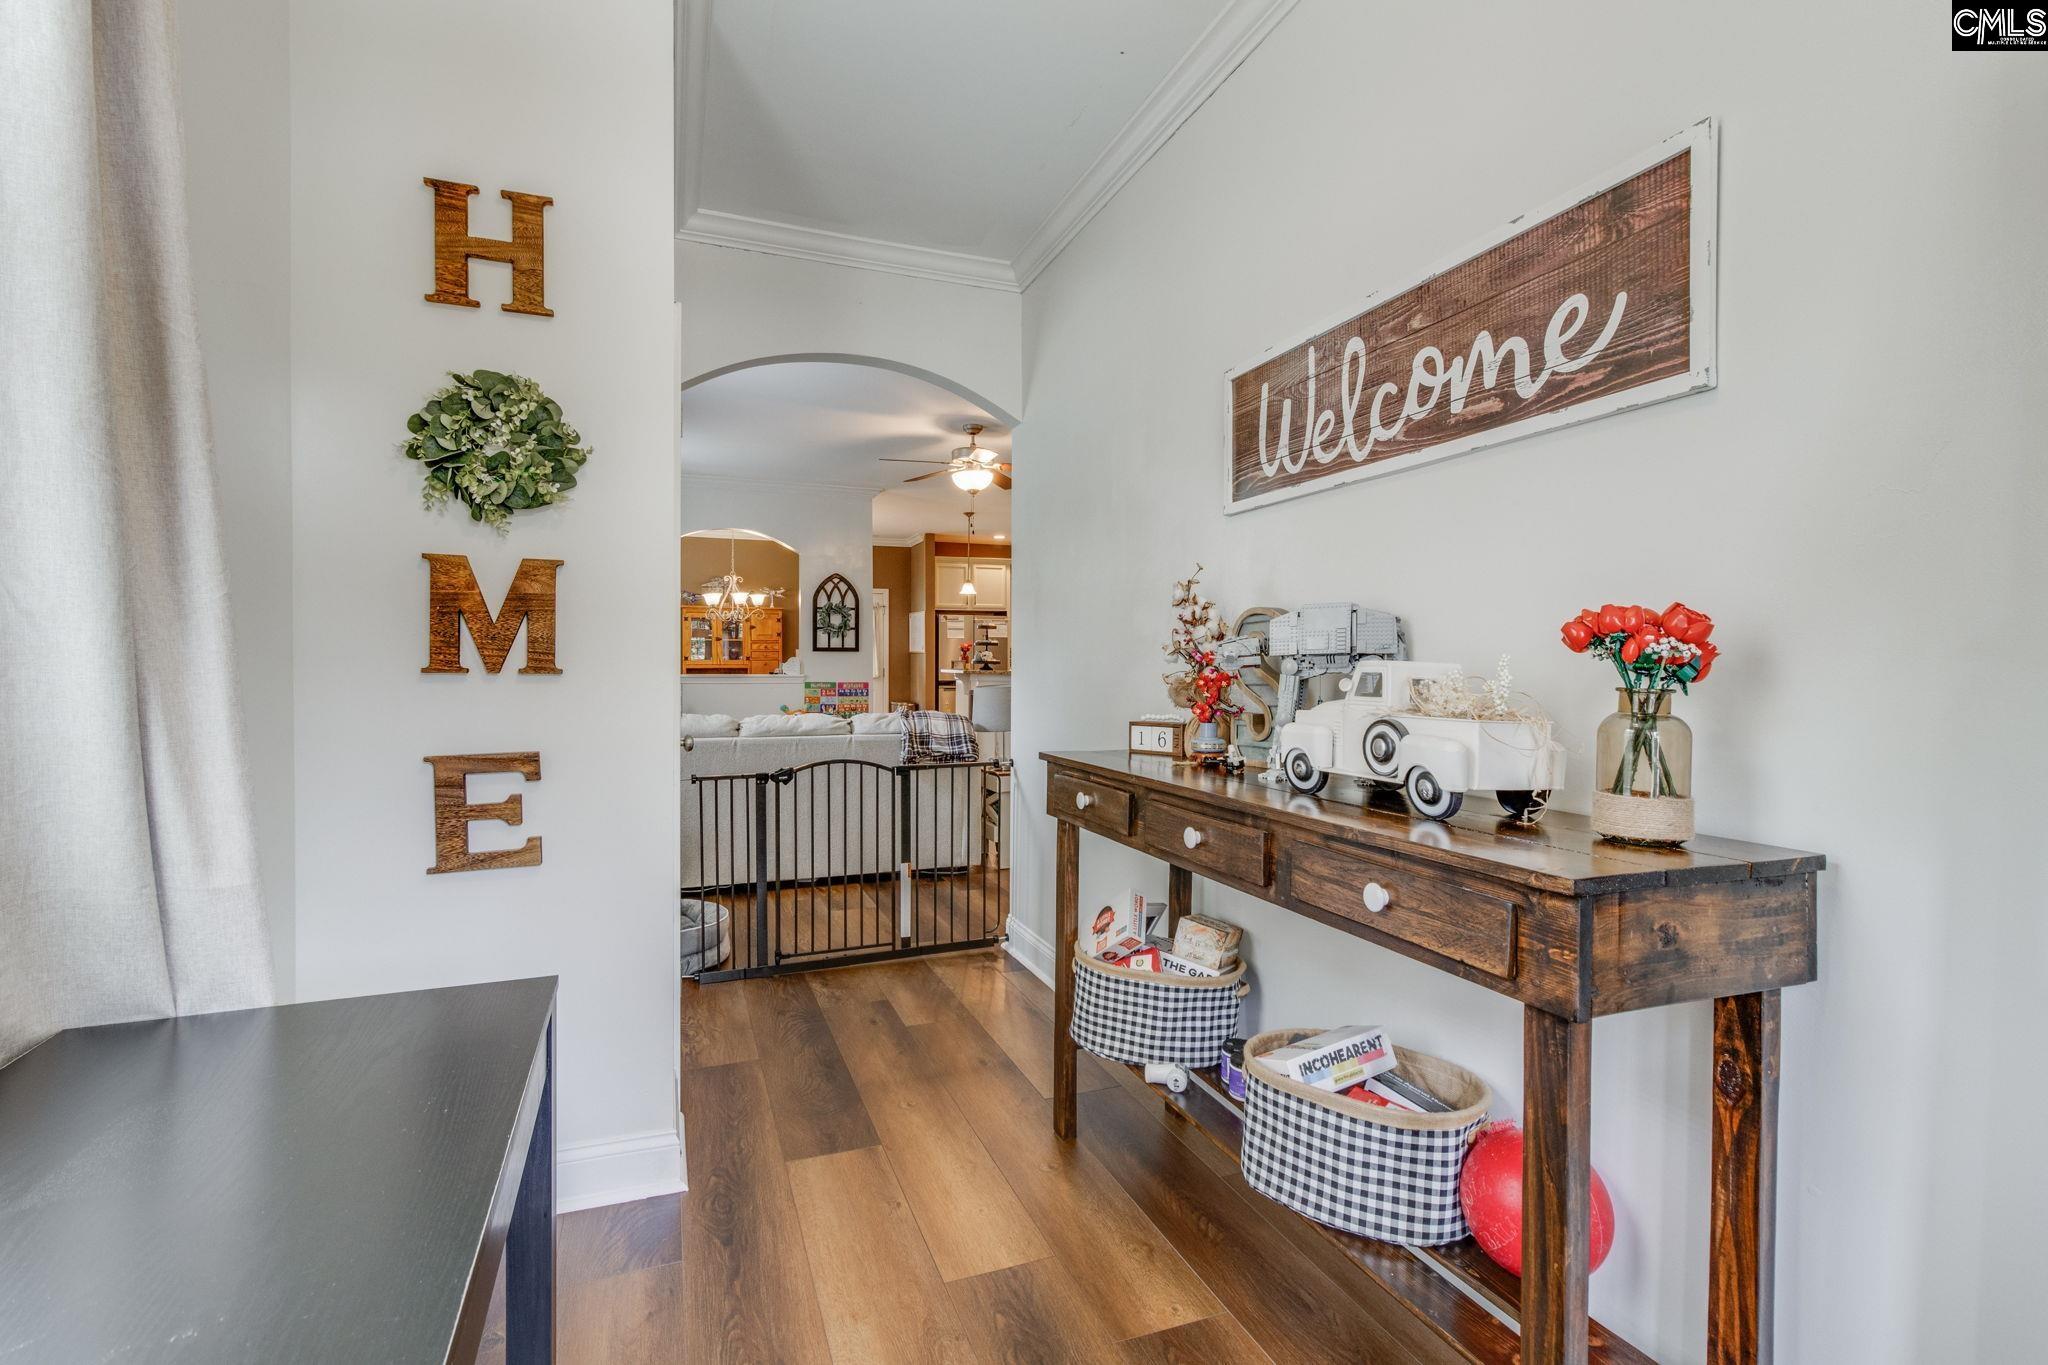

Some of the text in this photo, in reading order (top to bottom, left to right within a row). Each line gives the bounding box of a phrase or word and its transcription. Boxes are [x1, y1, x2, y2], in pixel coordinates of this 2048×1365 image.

[1260, 290, 1628, 478] Welcome
[1162, 957, 1187, 974] THE
[1298, 1034, 1383, 1077] INCOHEARENT
